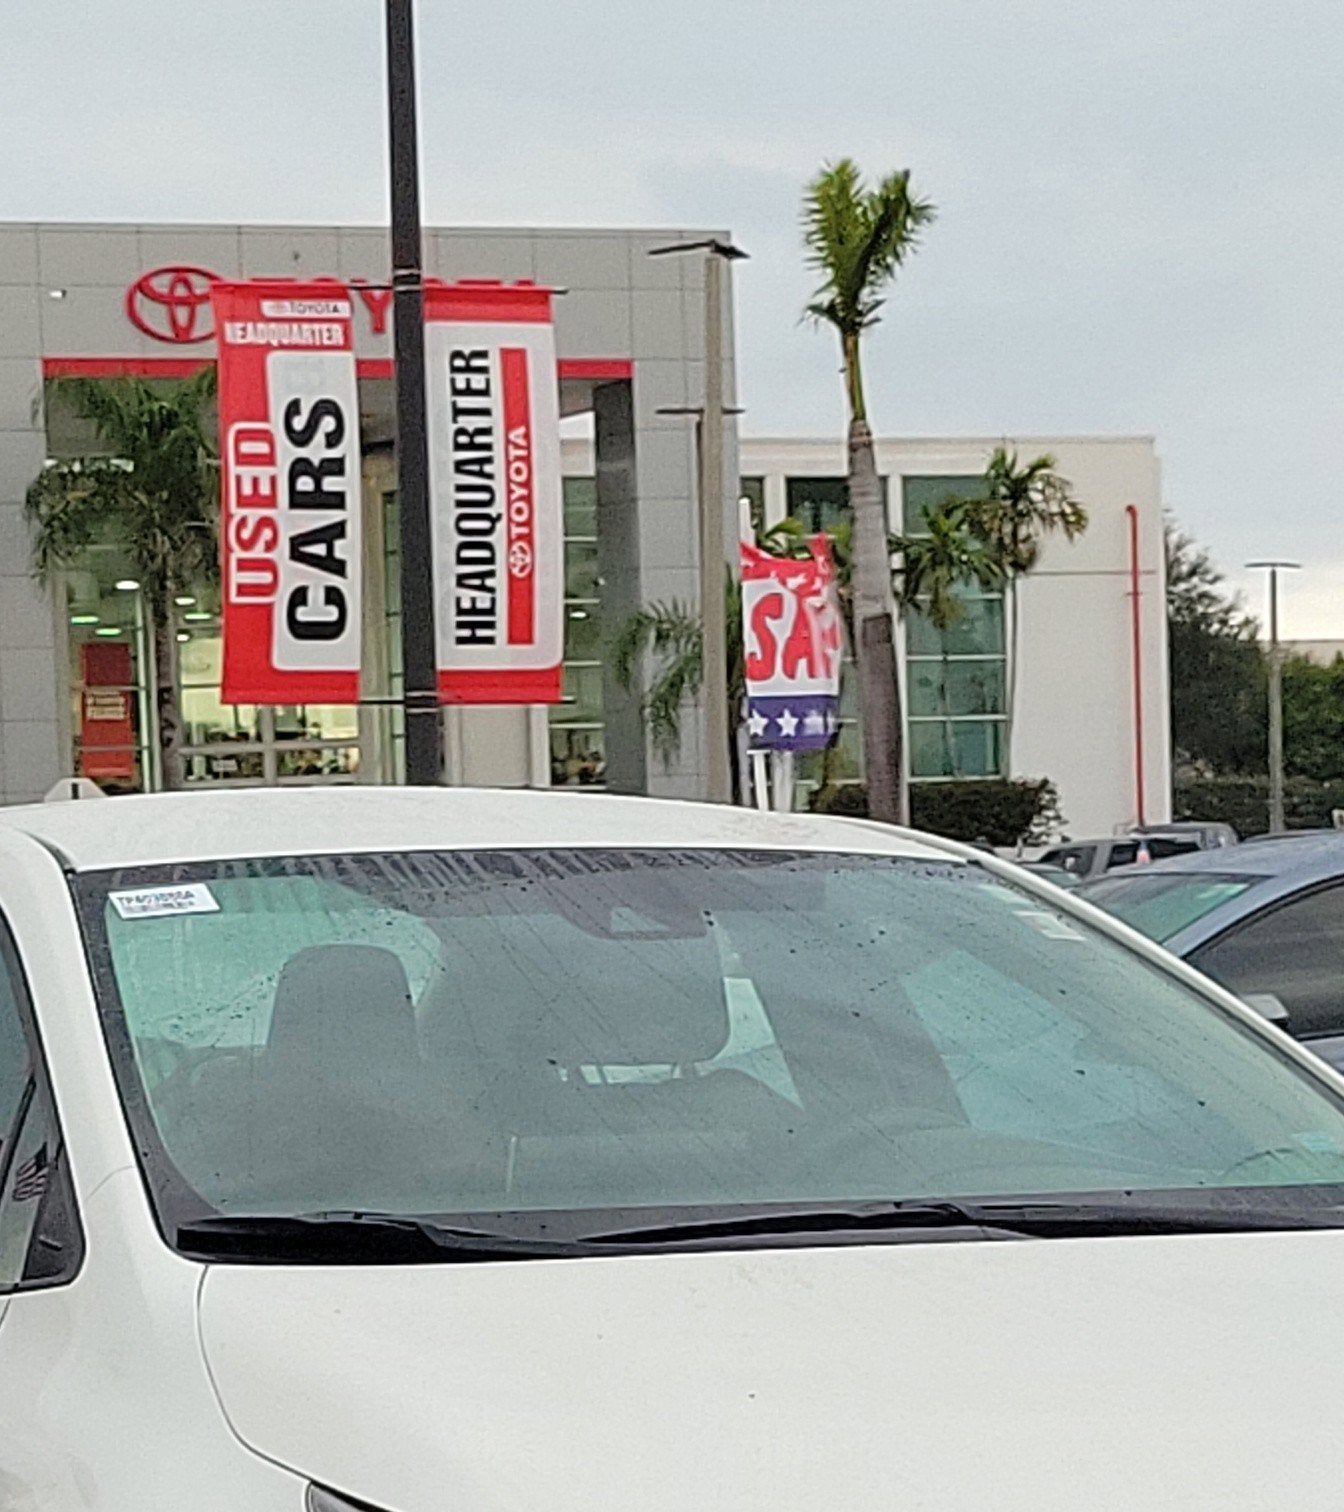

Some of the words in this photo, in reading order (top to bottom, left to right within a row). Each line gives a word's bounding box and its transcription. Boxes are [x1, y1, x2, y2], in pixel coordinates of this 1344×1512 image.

[233, 429, 279, 600] USED
[284, 397, 348, 642] CARS
[449, 348, 503, 646] HEADQUARTER
[507, 425, 531, 539] TOYOTA
